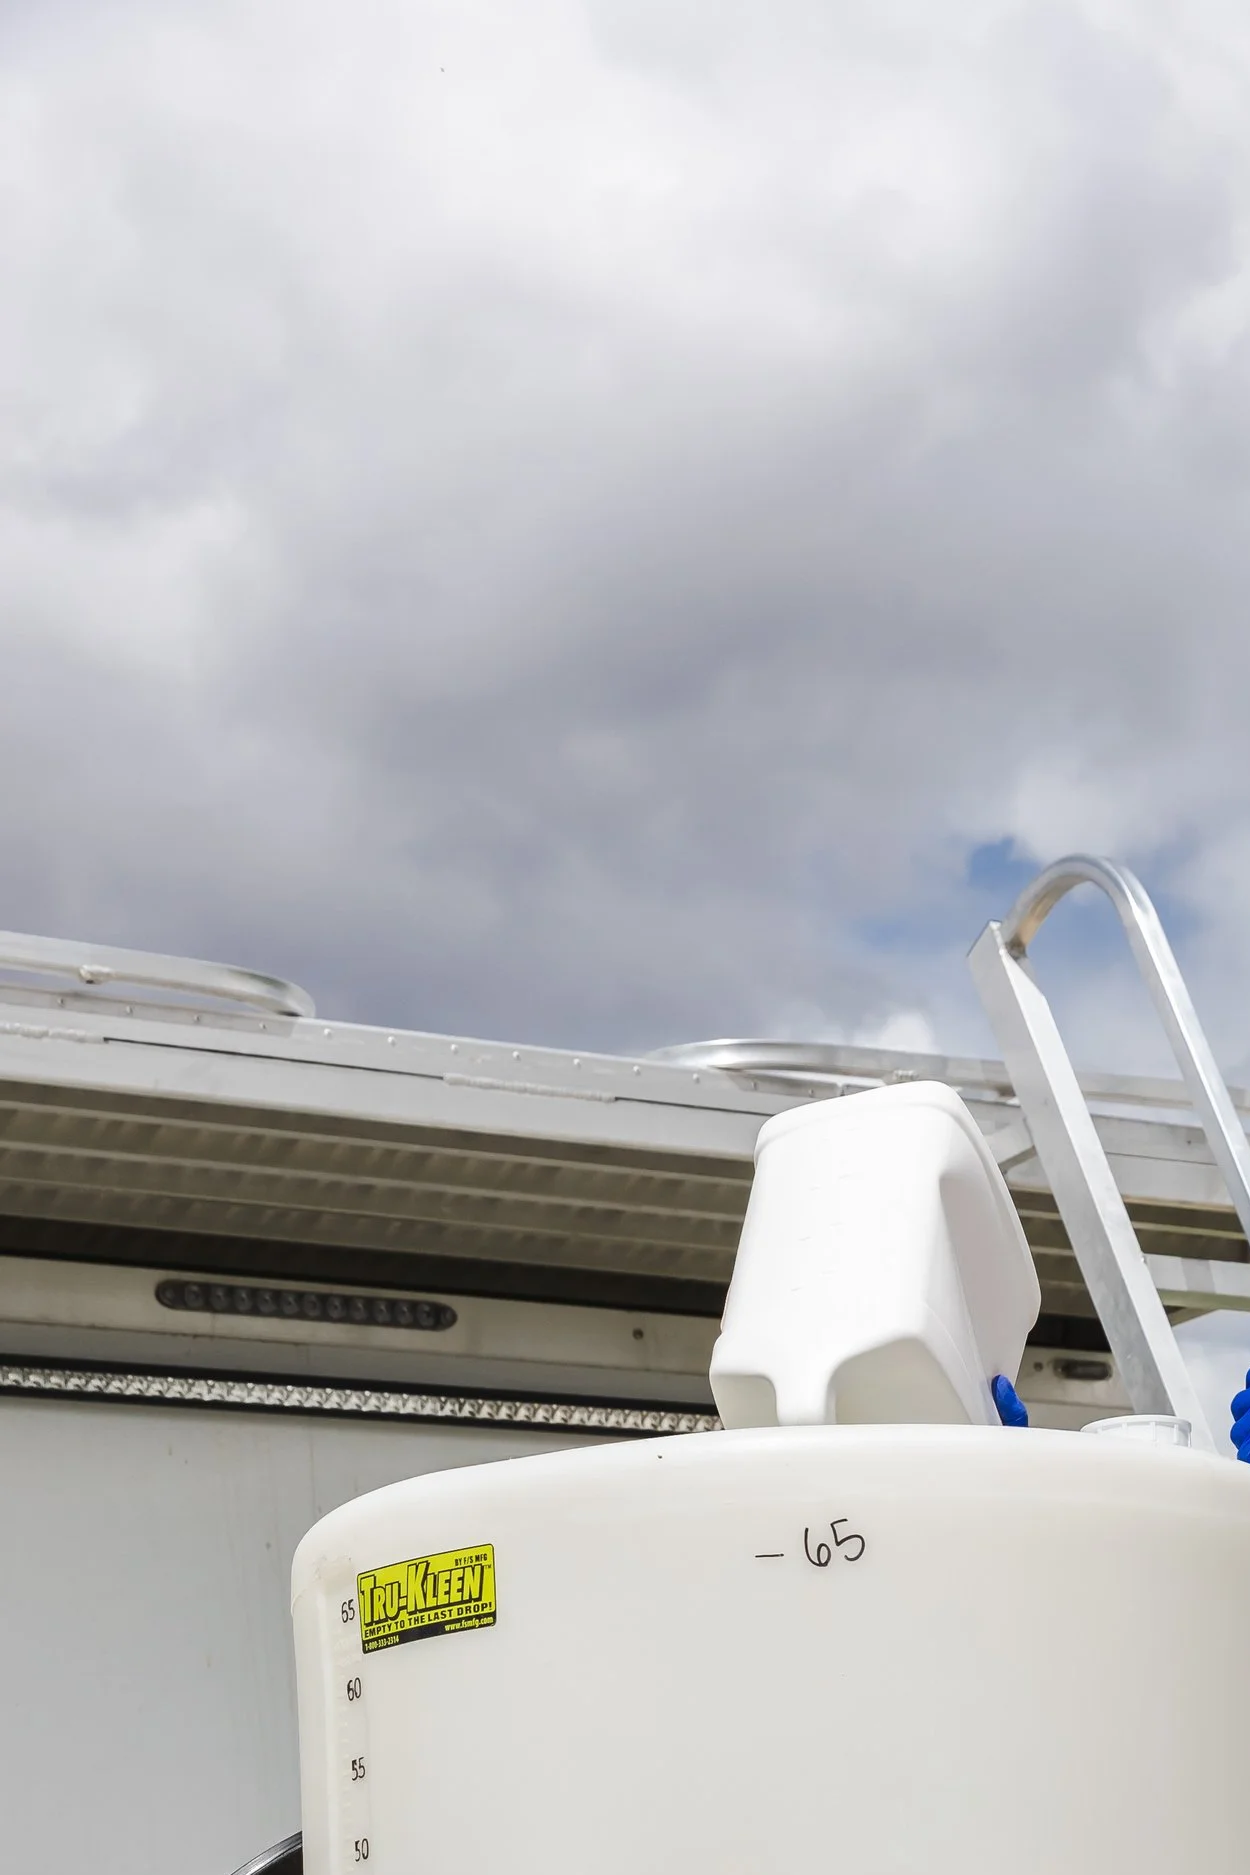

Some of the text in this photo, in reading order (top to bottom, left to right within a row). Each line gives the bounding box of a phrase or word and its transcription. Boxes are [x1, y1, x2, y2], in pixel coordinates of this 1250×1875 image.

[804, 1518, 865, 1567] 65
[454, 1553, 488, 1567] BY F/S MFG
[341, 1599, 356, 1624] 65
[364, 1601, 493, 1639] EMPTY TO THE LAST DROP!
[444, 1616, 494, 1632] www.fsmfg.com
[347, 1677, 362, 1701] 60
[351, 1757, 366, 1781] 55
[355, 1838, 369, 1862] 50
